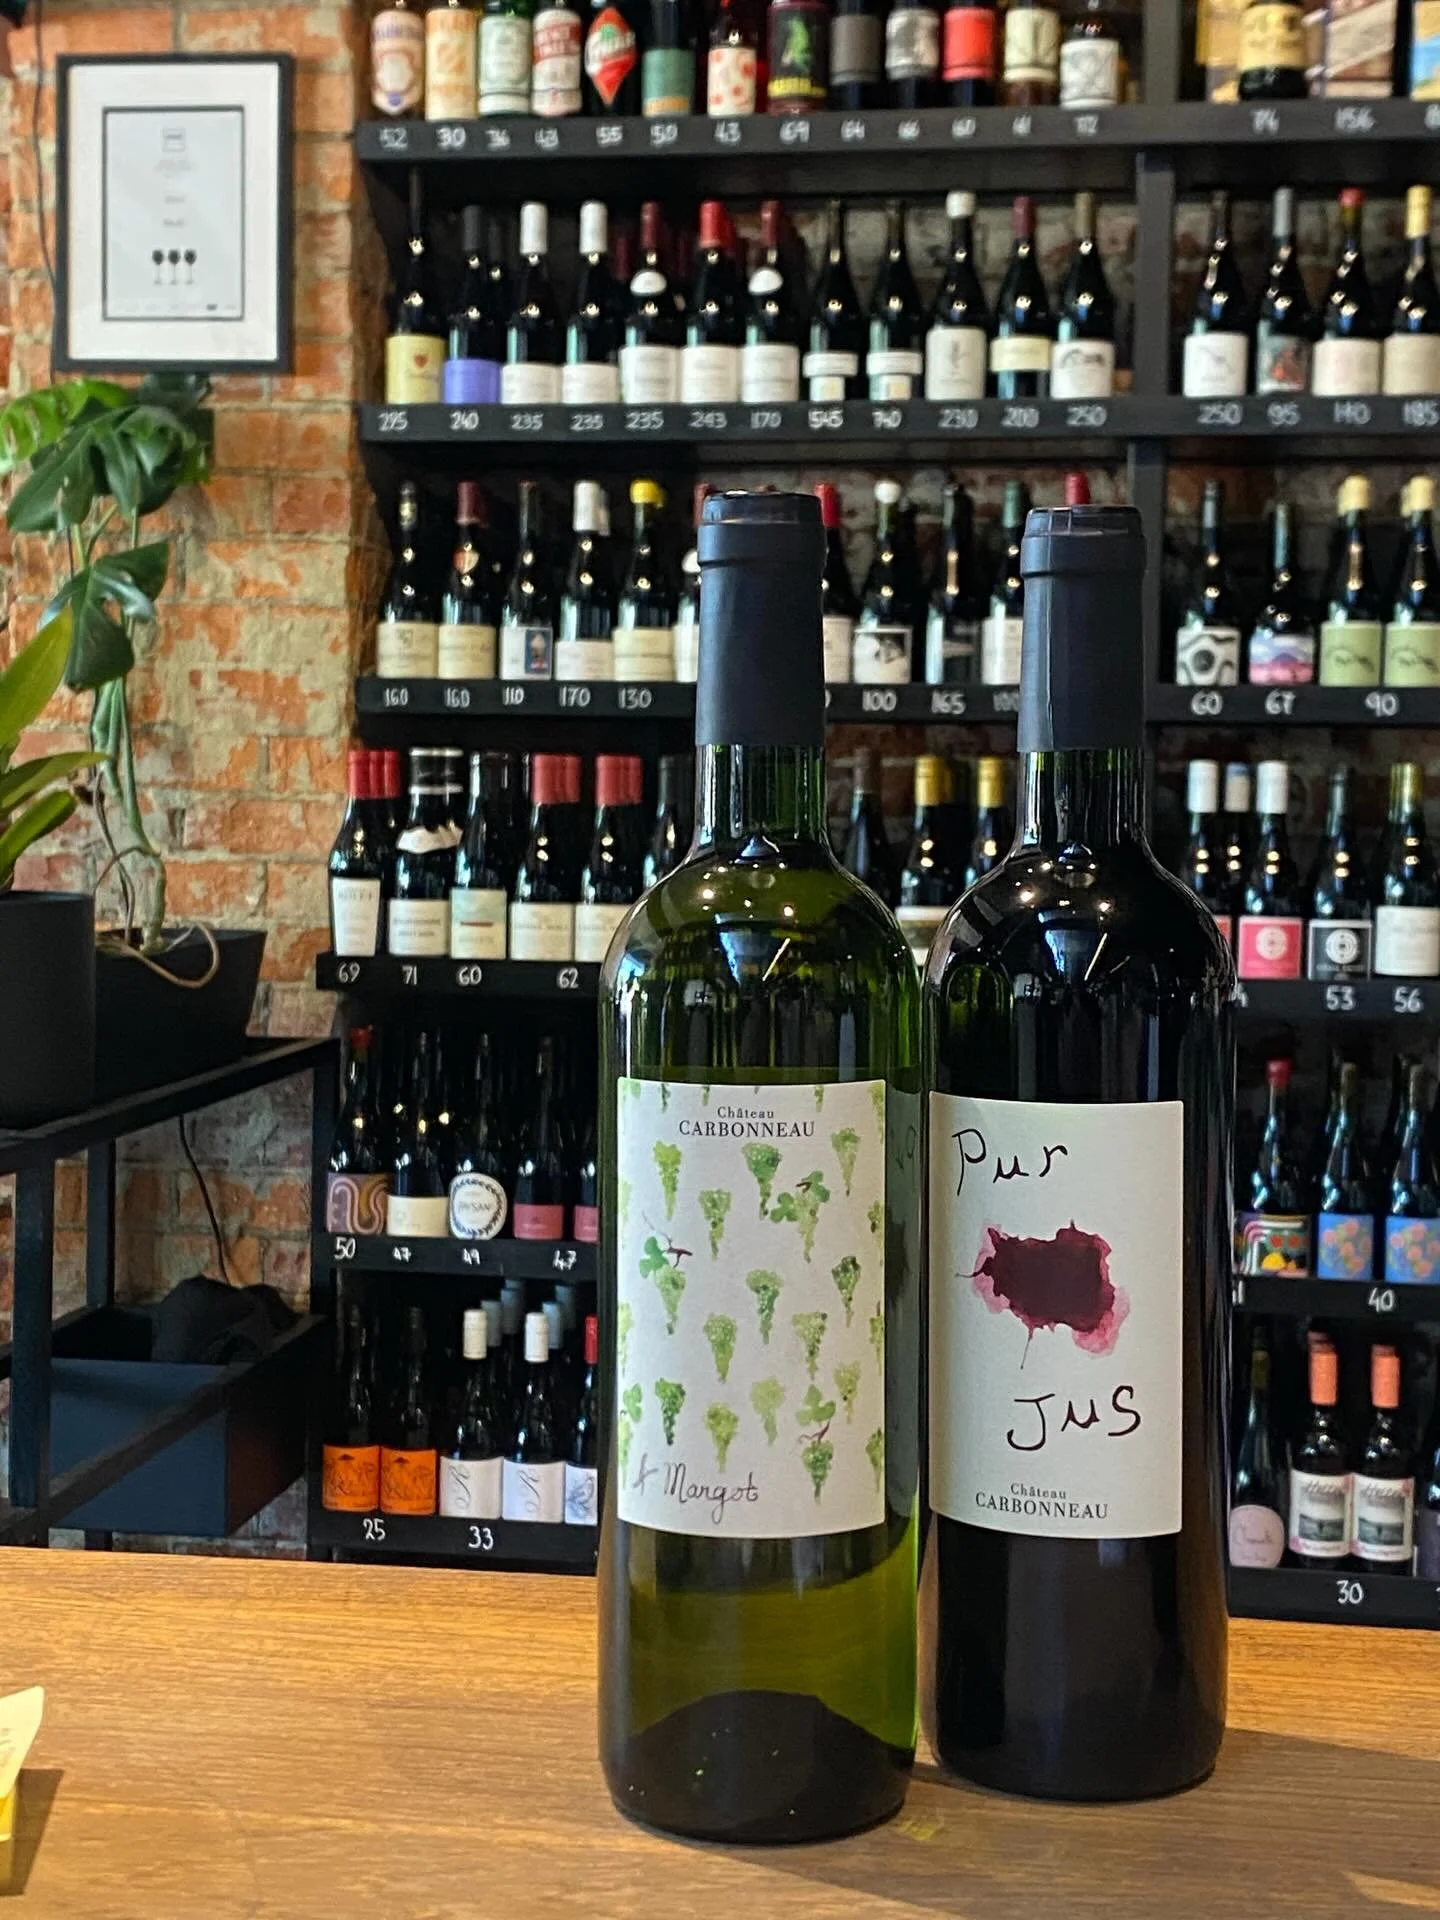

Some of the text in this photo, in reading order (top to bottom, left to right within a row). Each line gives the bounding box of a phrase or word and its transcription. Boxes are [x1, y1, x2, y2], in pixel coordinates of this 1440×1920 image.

[436, 127, 466, 148] 30
[451, 411, 479, 430] 240
[511, 413, 543, 431] 235
[625, 411, 664, 430] 235
[689, 411, 727, 429] 243
[384, 687, 409, 706] 160
[445, 687, 471, 708] 160
[559, 687, 591, 706] 170
[619, 688, 652, 708] 130
[862, 689, 897, 712] 100
[931, 690, 966, 714] 165
[1191, 690, 1223, 715] 60
[1265, 690, 1296, 714] 67
[1365, 691, 1398, 716] 90
[338, 964, 360, 982] 69
[402, 965, 417, 985] 71
[459, 966, 482, 986] 60
[557, 968, 579, 988] 62
[1326, 984, 1356, 1011] 53
[1394, 985, 1424, 1013] 56
[717, 1106, 774, 1119] Château
[679, 1120, 815, 1137] CARBONNEAU
[951, 1128, 1068, 1197] Pur
[334, 1237, 356, 1260] 50
[1368, 1288, 1395, 1312] 40
[664, 1462, 759, 1524] Margot
[1010, 1484, 1067, 1499] Château
[975, 1491, 1109, 1519] CARBONNEAU
[362, 1518, 386, 1541] 25
[468, 1526, 494, 1550] 33
[1336, 1580, 1364, 1604] 30
